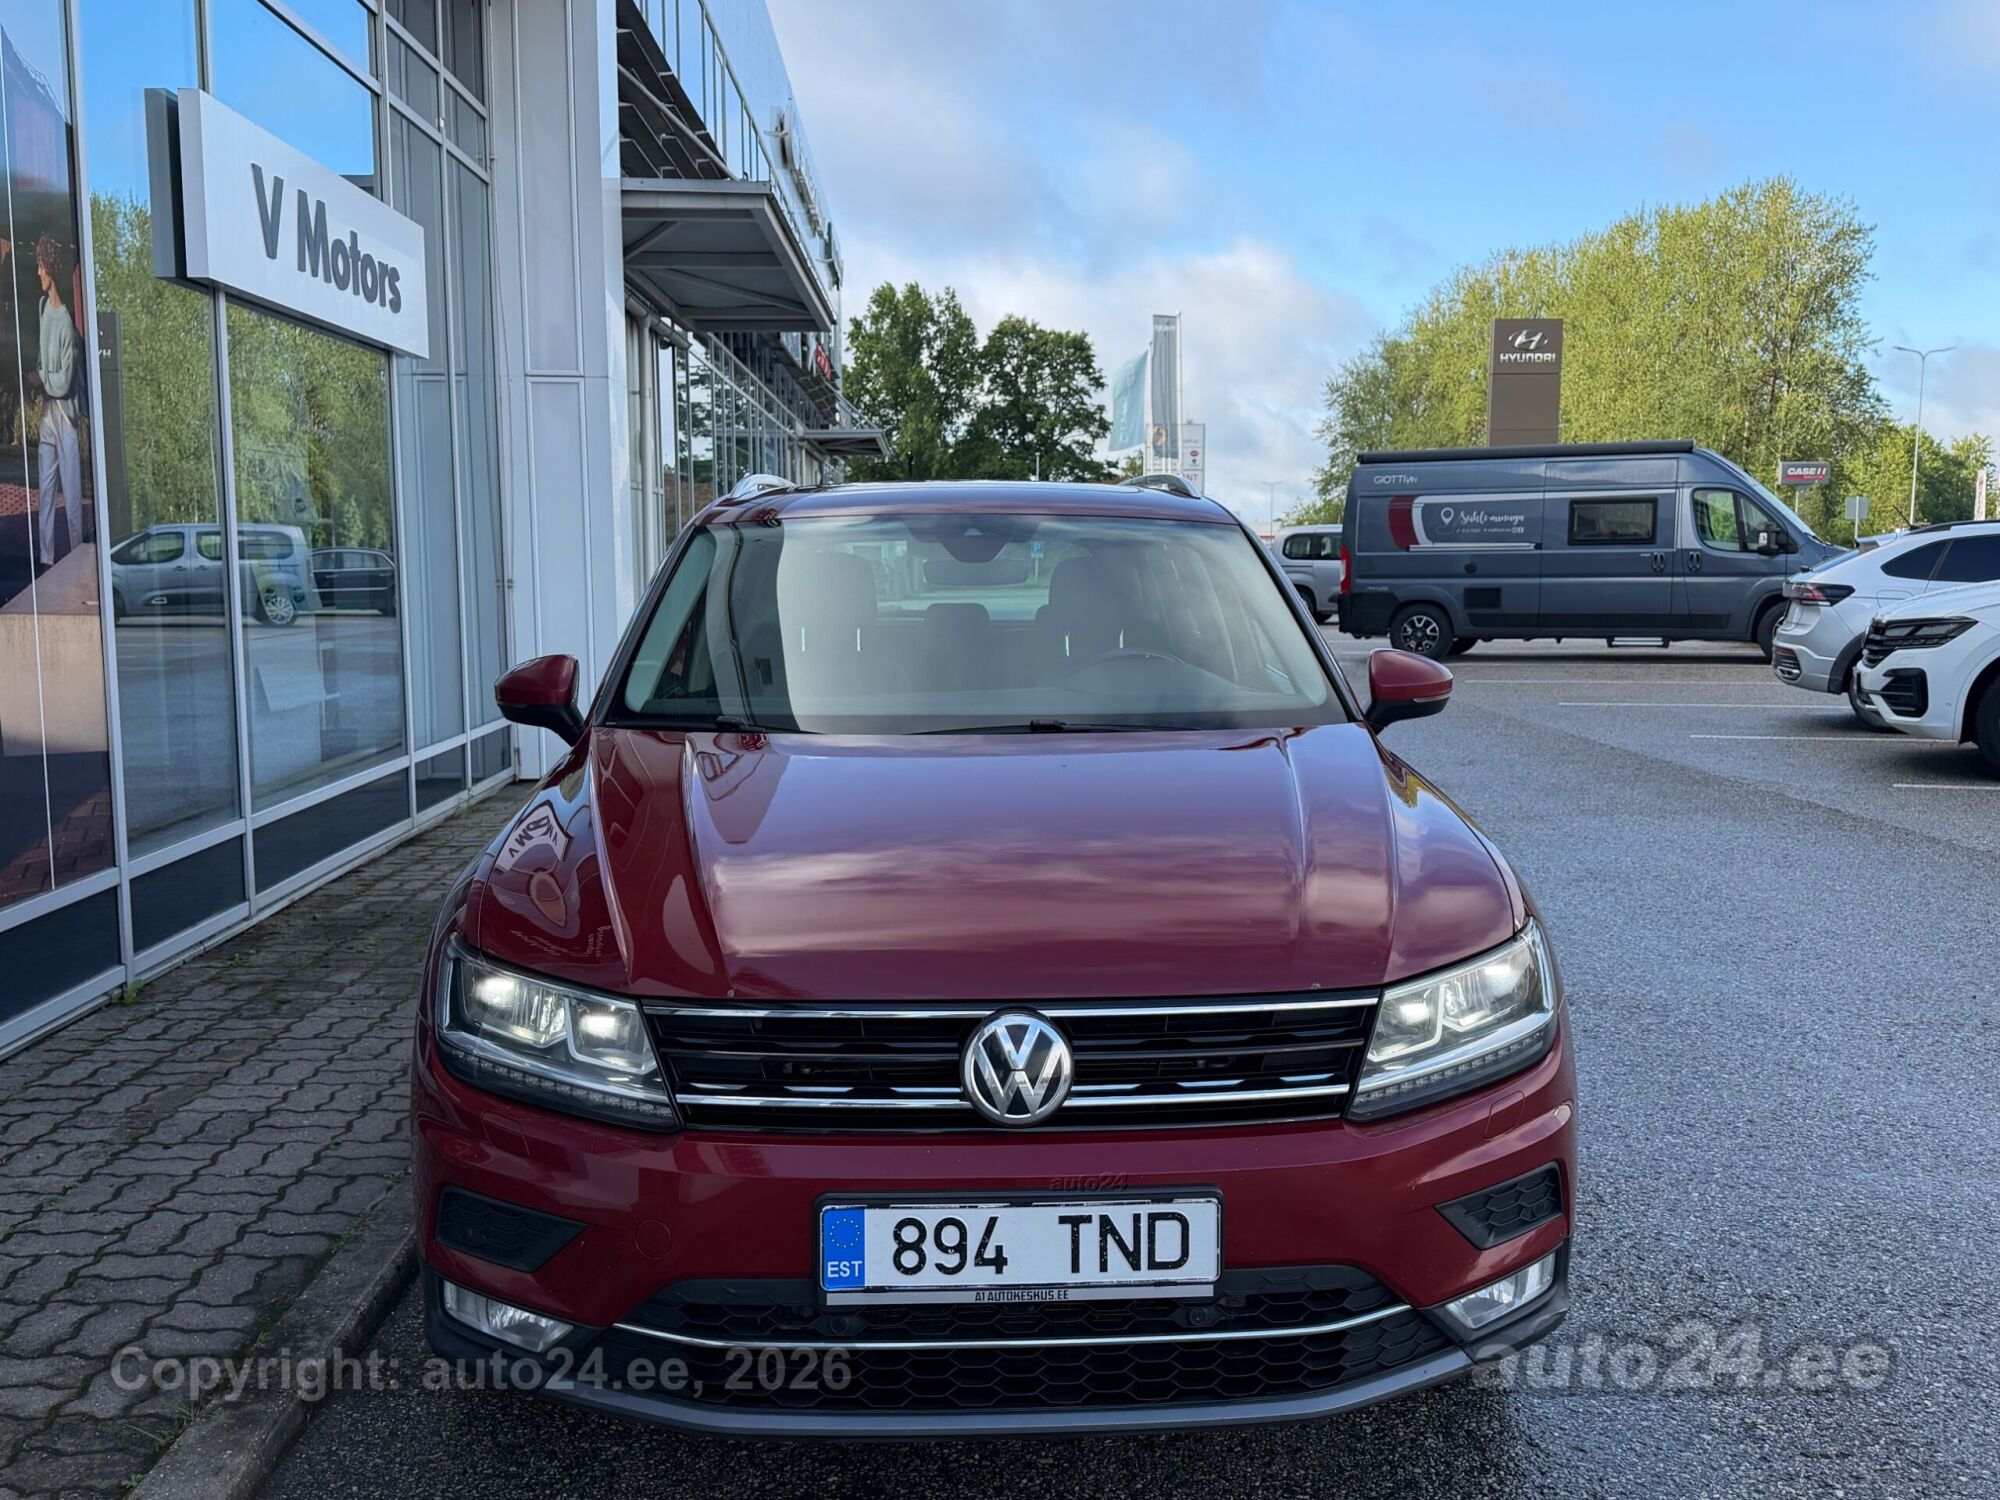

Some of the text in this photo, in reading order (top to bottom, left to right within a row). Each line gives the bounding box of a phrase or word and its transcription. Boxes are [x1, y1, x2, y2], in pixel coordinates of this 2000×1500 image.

[251, 163, 402, 314] V Motors
[1499, 353, 1556, 363] HYUNDAI
[1787, 467, 1817, 475] CASE
[893, 1211, 1190, 1276] 894 TND
[826, 1261, 863, 1278] EST
[987, 1289, 1069, 1302] AUTOKESKUS.EE
